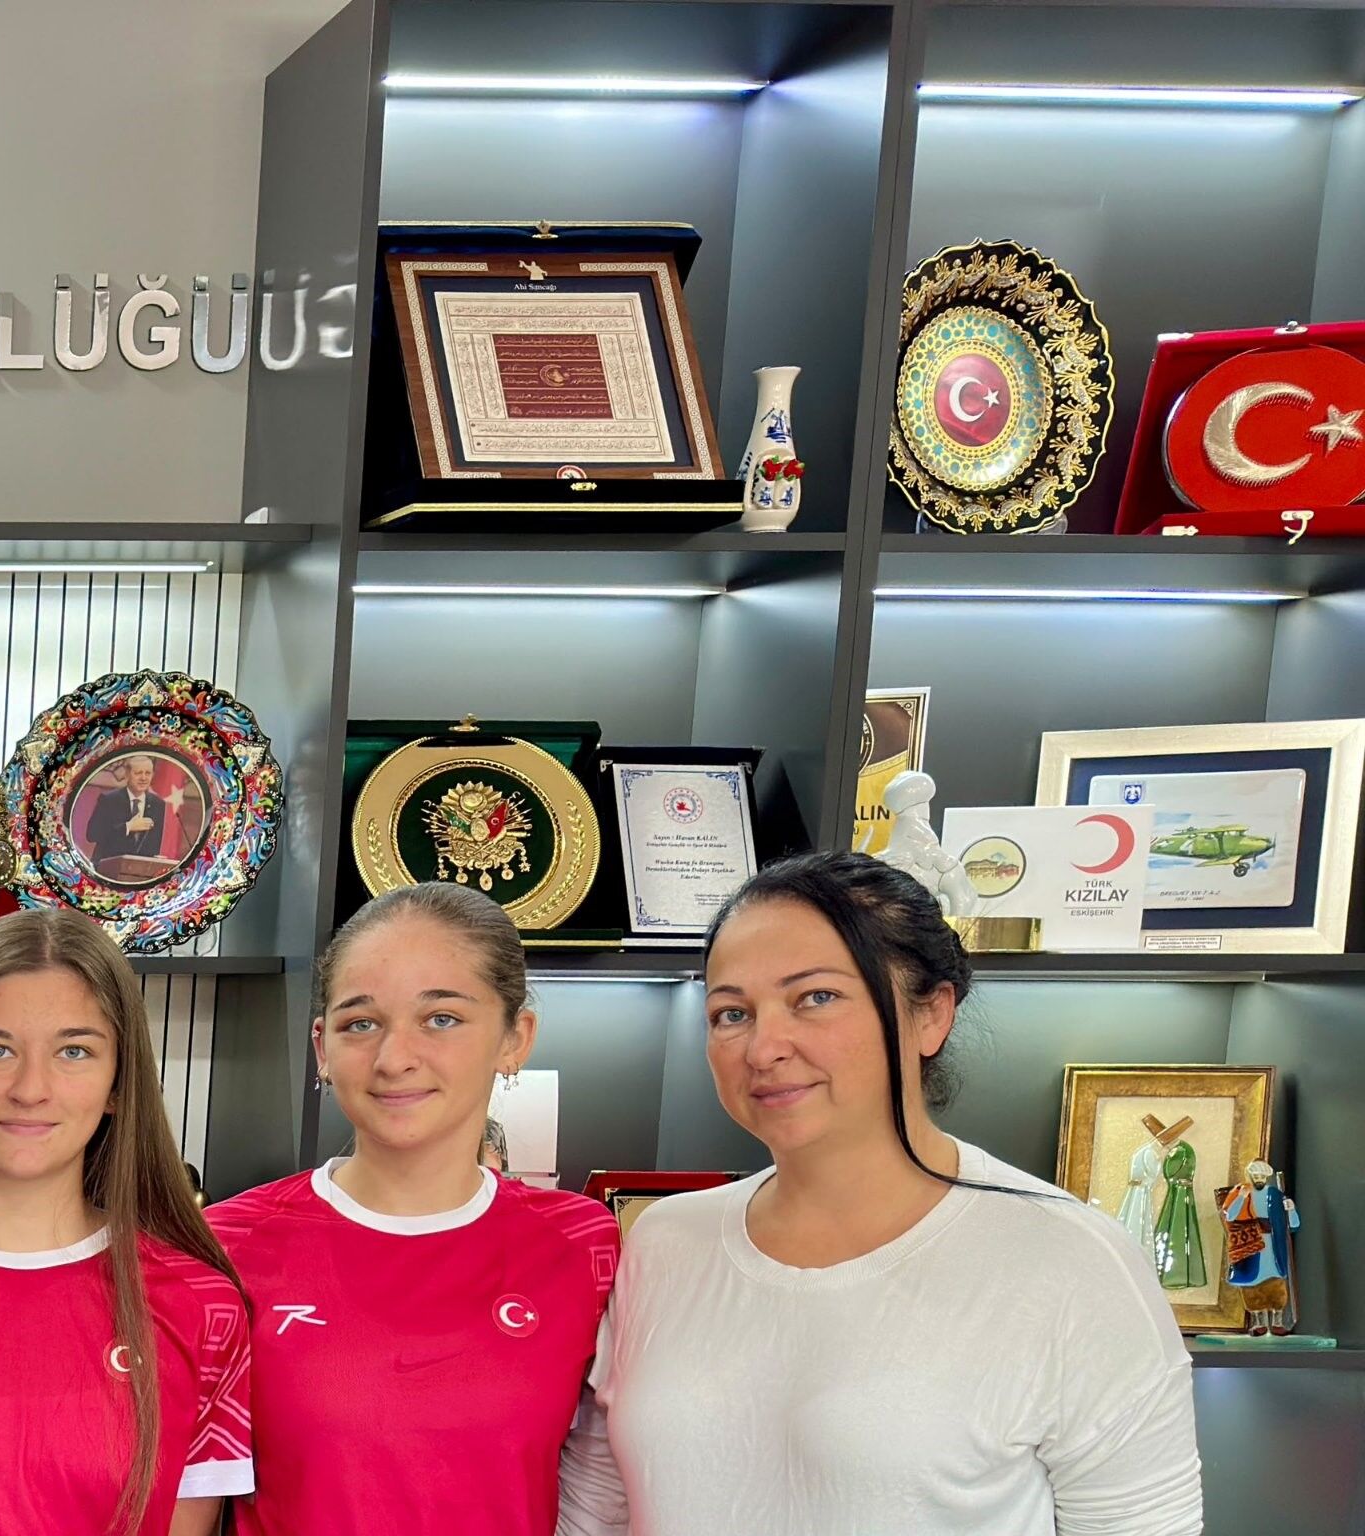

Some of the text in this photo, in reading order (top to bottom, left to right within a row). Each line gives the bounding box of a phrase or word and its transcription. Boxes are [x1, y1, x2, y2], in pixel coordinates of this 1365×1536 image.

[1084, 879, 1113, 888] TÜRK
[1064, 889, 1130, 902] KIZILAY
[1070, 908, 1115, 917] ESKİŞEHİR
